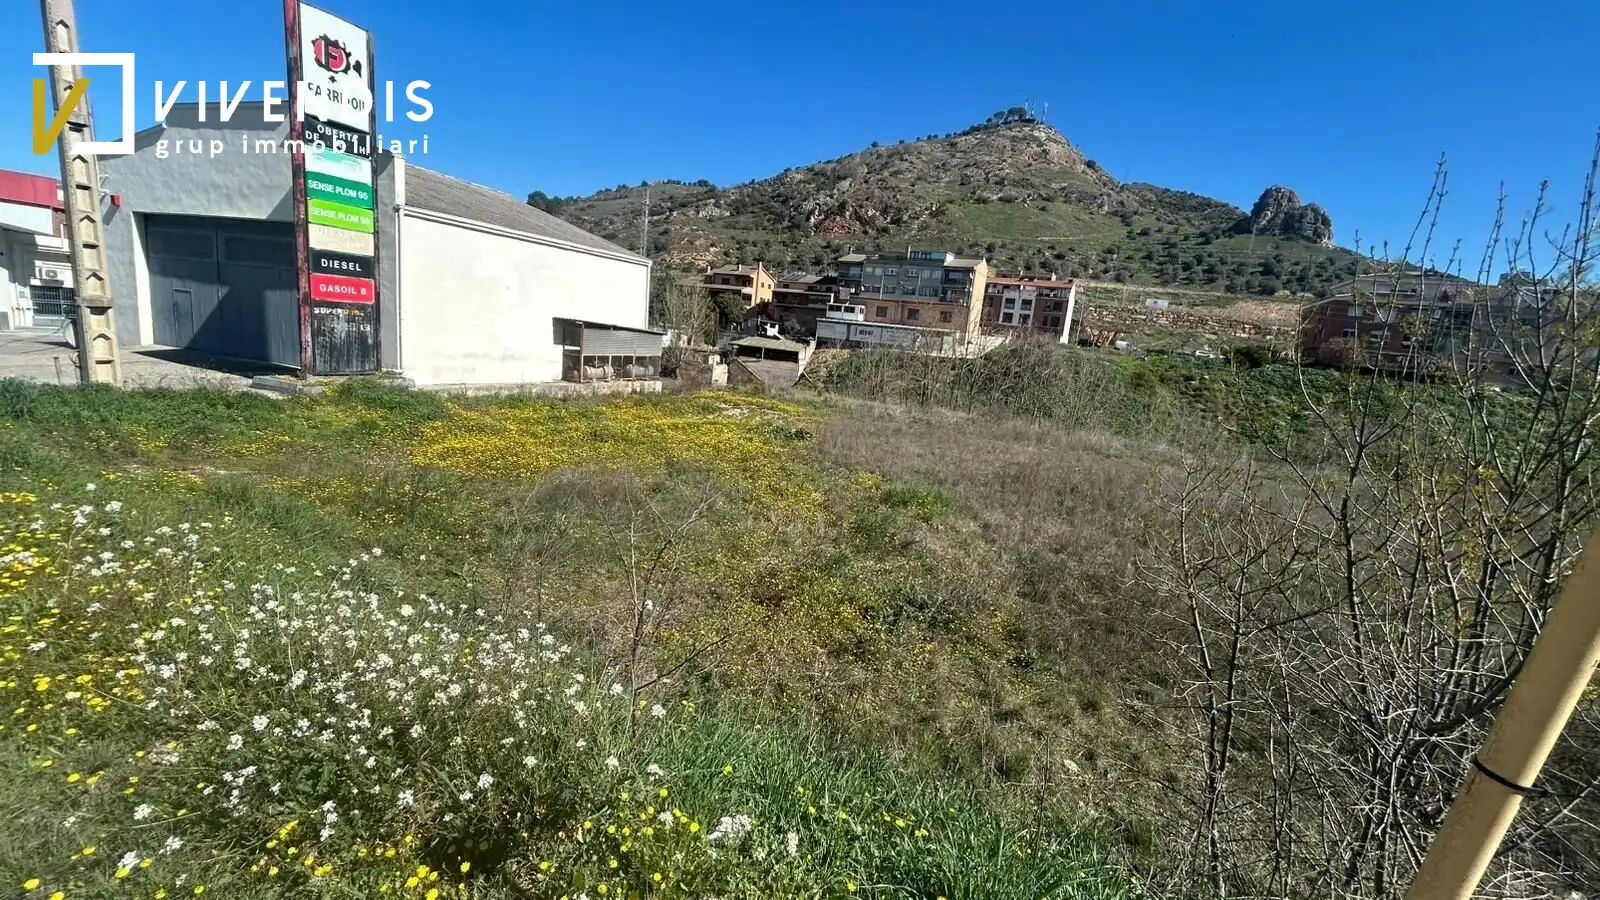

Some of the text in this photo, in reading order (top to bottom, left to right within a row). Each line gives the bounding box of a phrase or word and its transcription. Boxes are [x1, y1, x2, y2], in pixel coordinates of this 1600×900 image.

[307, 180, 369, 200] SENSE PLOM 95
[311, 207, 336, 219] SENSE
[338, 211, 358, 223] PLOM
[321, 258, 362, 272] DIESEL
[319, 283, 368, 296] GASOIL B
